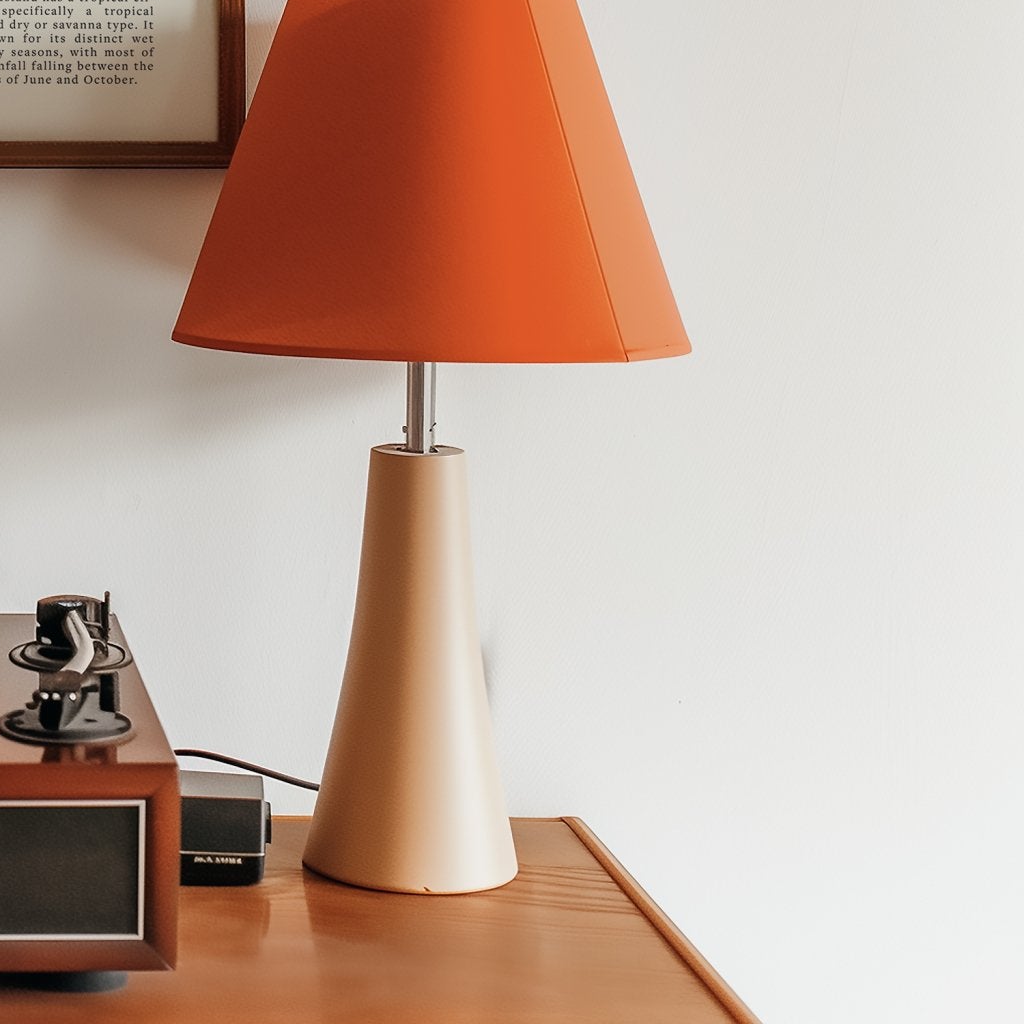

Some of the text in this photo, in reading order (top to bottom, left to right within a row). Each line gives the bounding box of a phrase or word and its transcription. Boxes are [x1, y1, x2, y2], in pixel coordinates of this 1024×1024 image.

[2, 6, 74, 19] specifically
[86, 8, 92, 16] a
[104, 6, 153, 19] tropical
[23, 33, 42, 43] for
[50, 33, 66, 43] its
[74, 33, 123, 43] distinct
[131, 34, 154, 43] wet
[11, 49, 63, 59] seasons,
[69, 47, 97, 57] with
[104, 48, 135, 57] most
[141, 47, 154, 57] of
[31, 60, 72, 74] falling
[77, 60, 128, 71] between
[134, 60, 154, 71] the
[6, 74, 20, 85] of
[23, 74, 52, 85] June
[56, 74, 79, 85] and
[83, 74, 137, 85] October.
